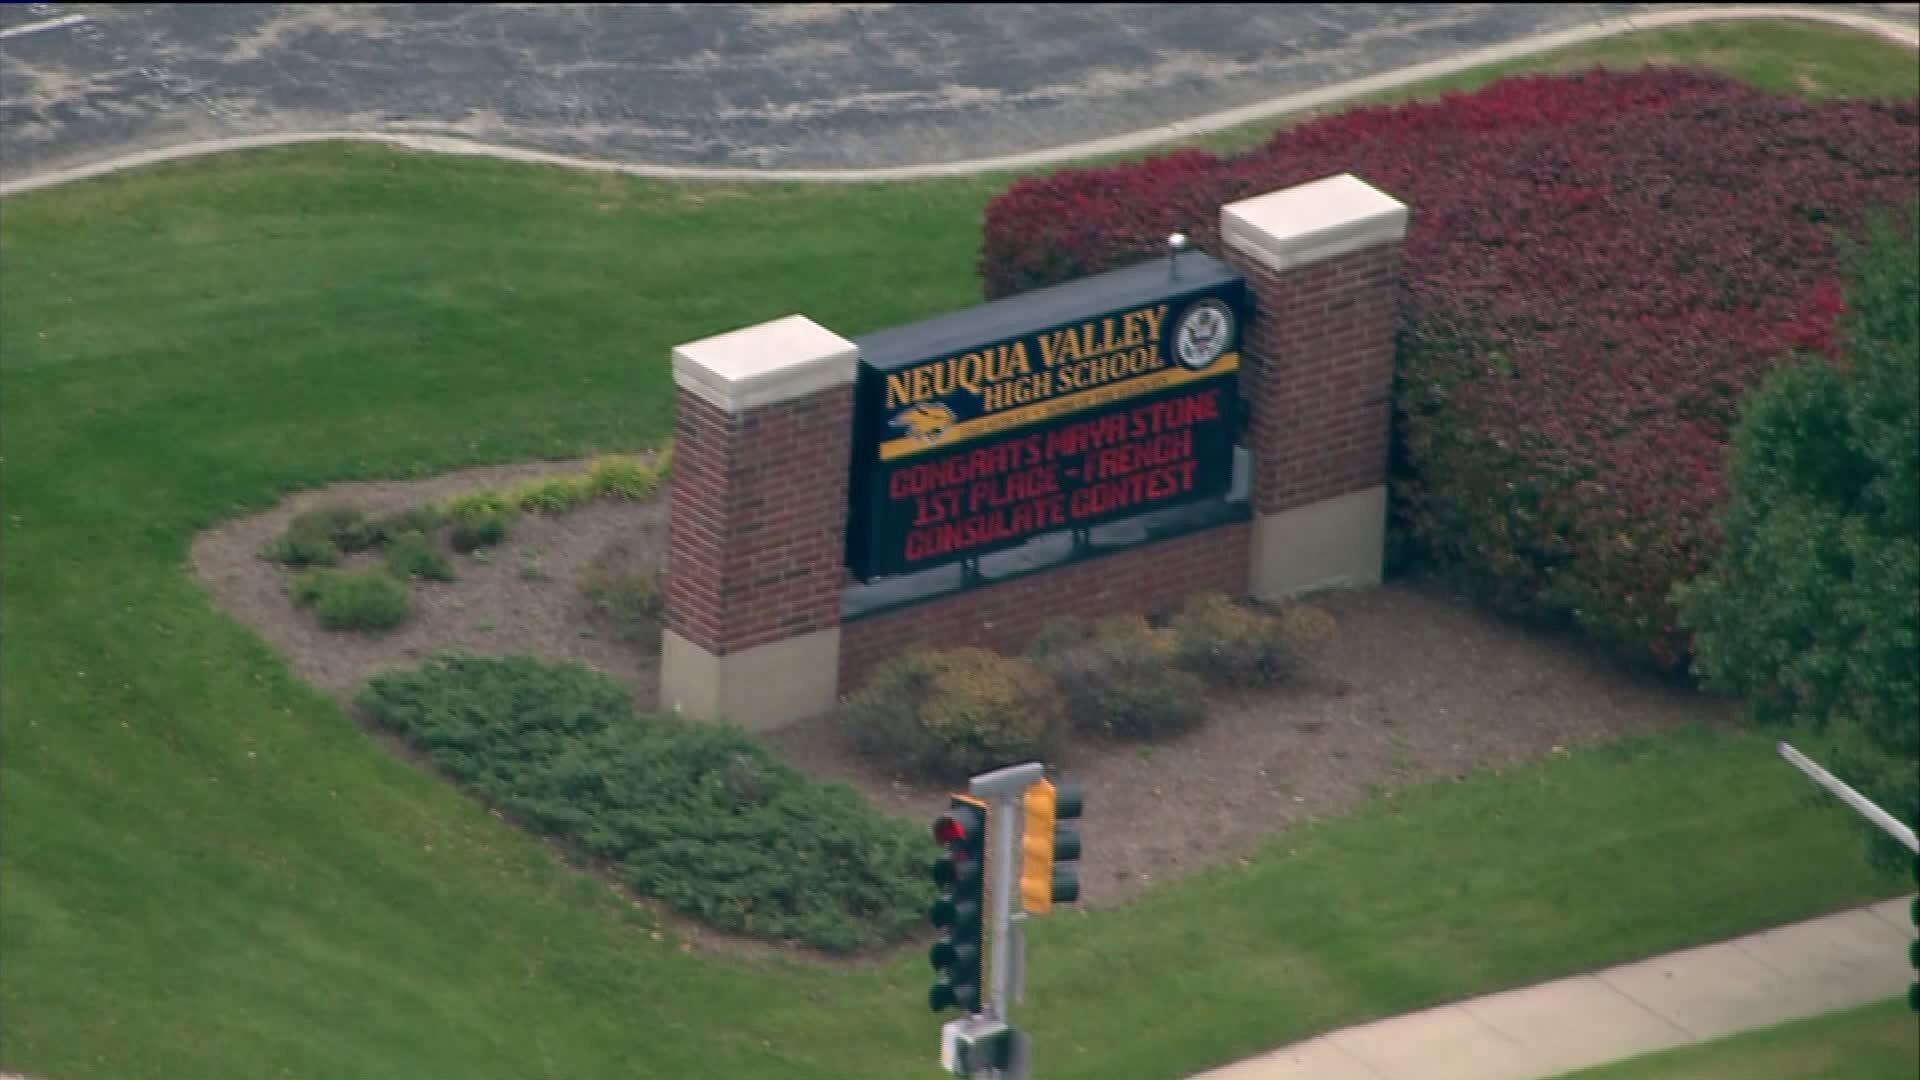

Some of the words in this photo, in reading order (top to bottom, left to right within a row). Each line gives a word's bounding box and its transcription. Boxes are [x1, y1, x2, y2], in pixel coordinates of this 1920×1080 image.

[886, 340, 1031, 409] NEUQUA
[1038, 304, 1168, 367] VALLEY
[984, 369, 1052, 411] HIGH
[1057, 344, 1165, 392] SCHOOL
[890, 431, 1042, 498] CONGRATS
[1046, 411, 1128, 461] MAYA
[1130, 388, 1220, 437] STONE
[913, 487, 963, 526] 1ST
[968, 461, 1060, 513] PLACE
[1083, 428, 1193, 482] FRENCH
[904, 493, 1066, 562] CONSULATE
[1070, 459, 1200, 519] CONTEST
